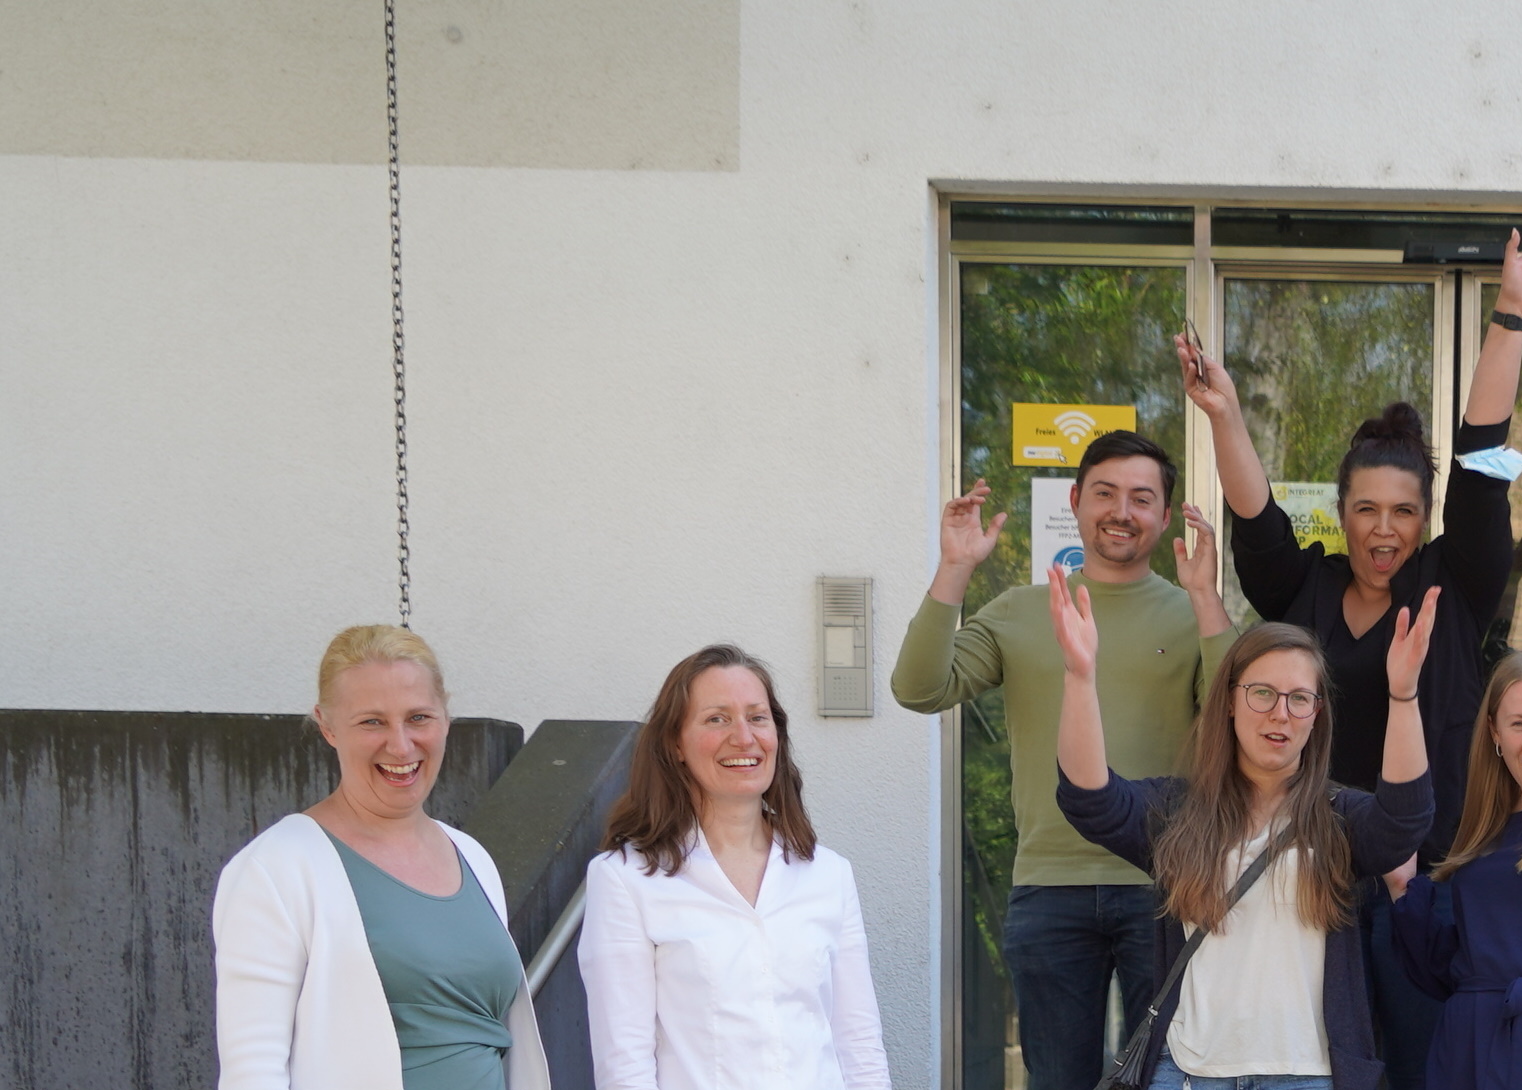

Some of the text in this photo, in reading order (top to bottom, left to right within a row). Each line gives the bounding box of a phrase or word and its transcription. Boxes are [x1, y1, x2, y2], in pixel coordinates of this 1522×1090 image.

[1035, 427, 1056, 436] Freies
[1288, 488, 1324, 496] INTEGREAT
[1290, 514, 1323, 524] OCAL
[1294, 525, 1345, 536] FORMAT
